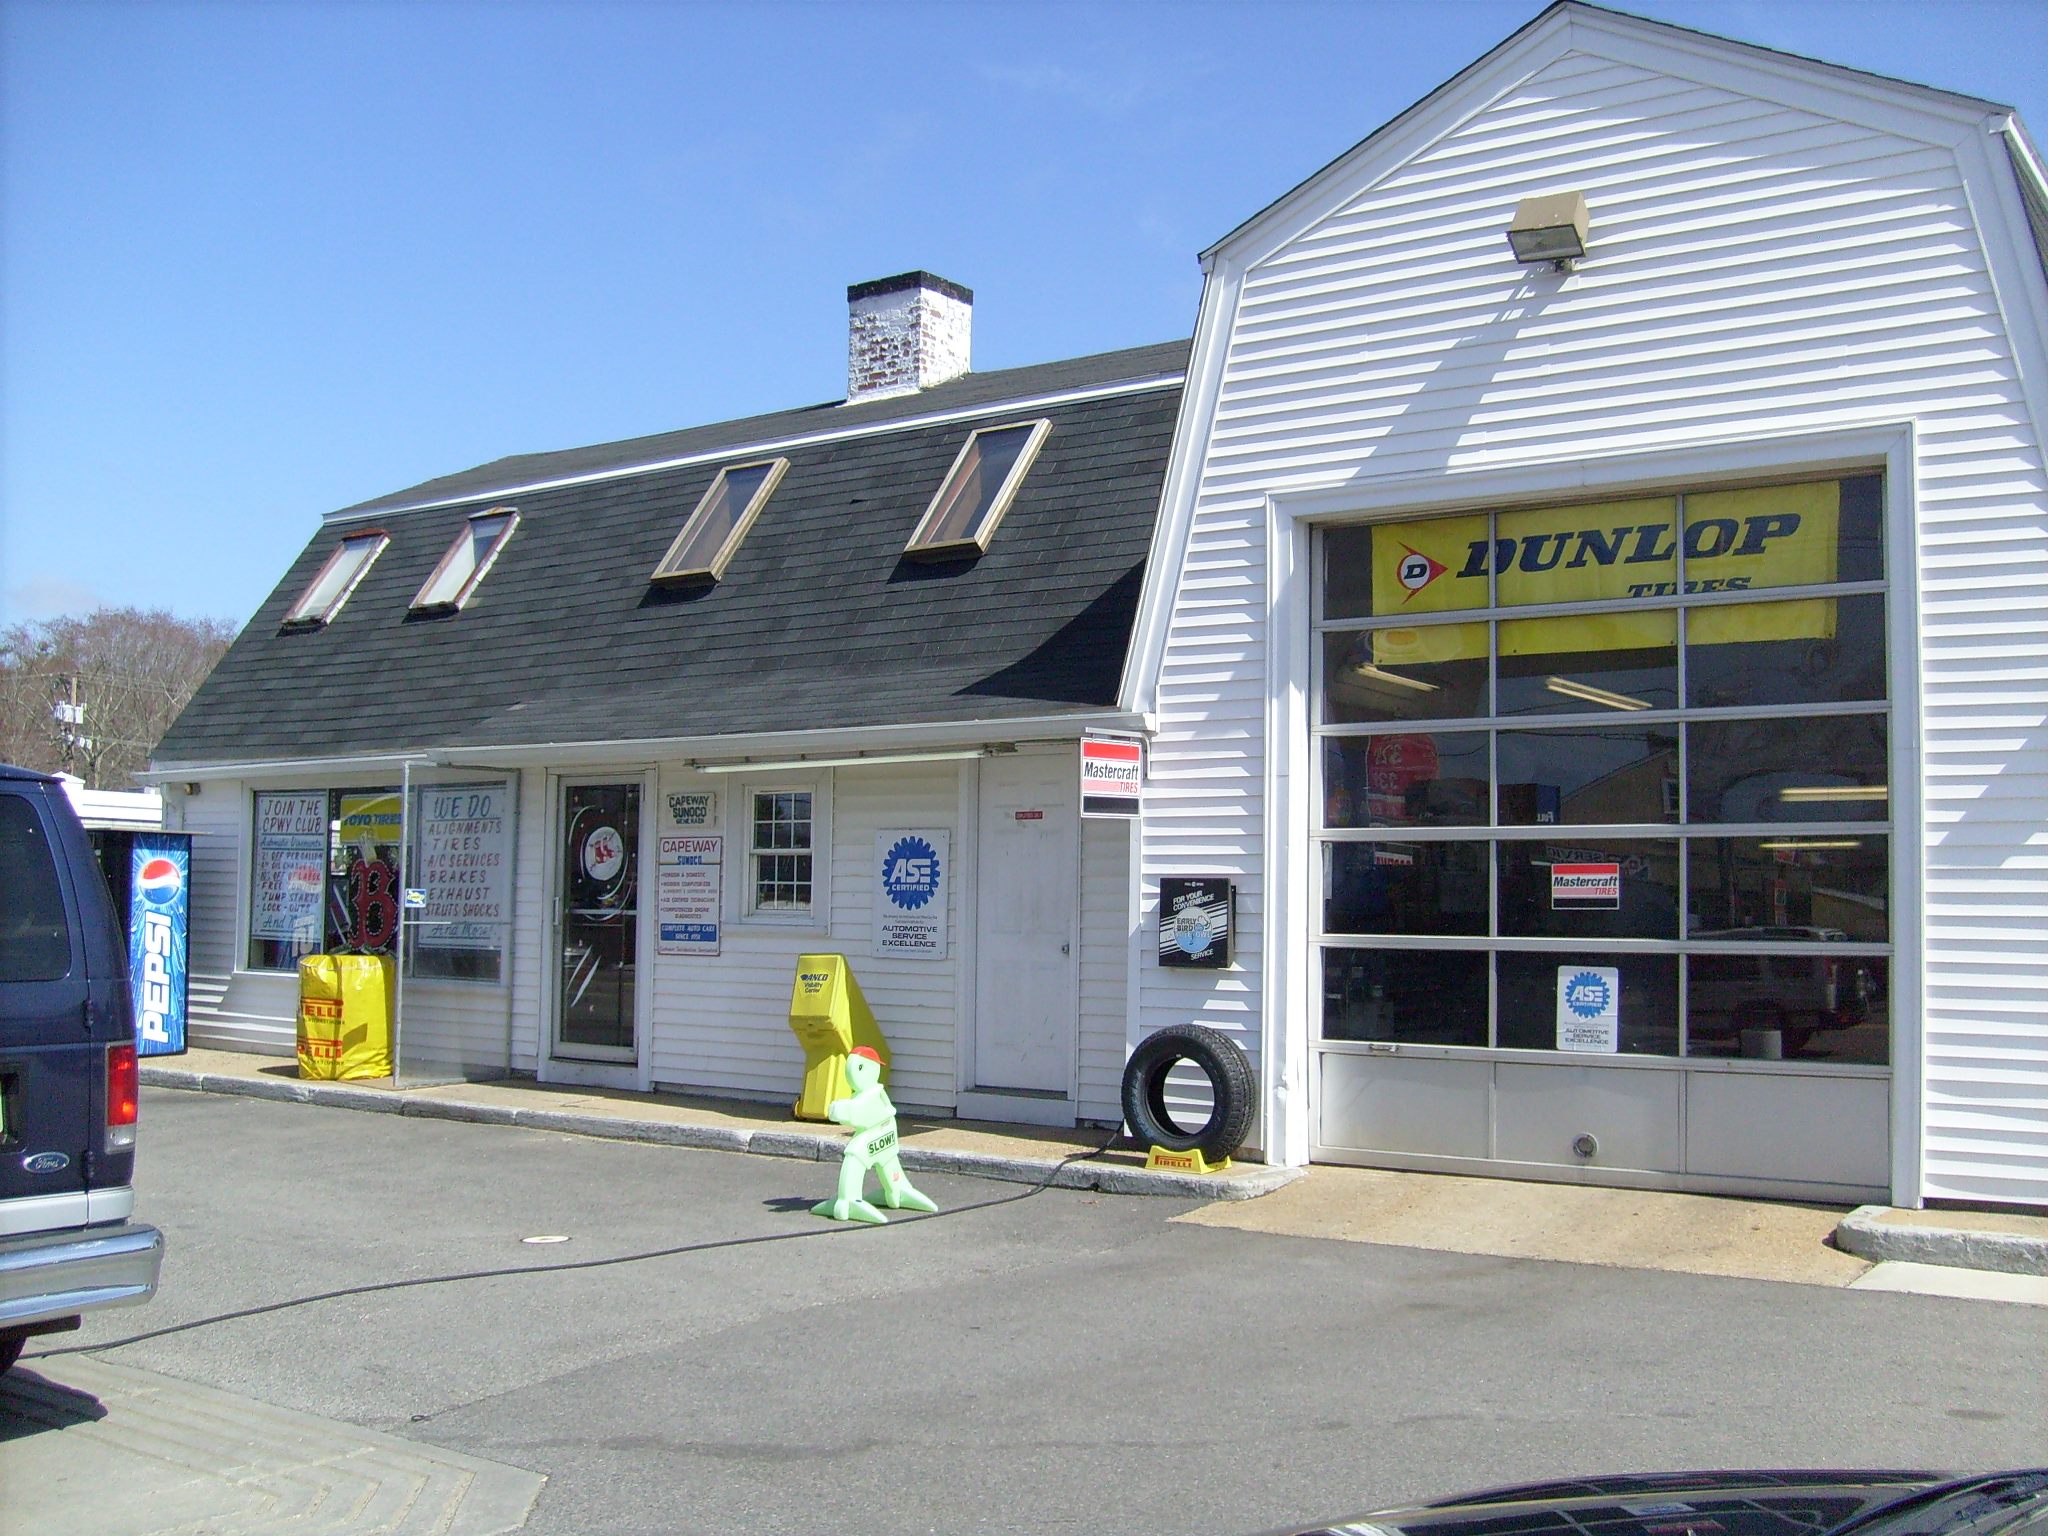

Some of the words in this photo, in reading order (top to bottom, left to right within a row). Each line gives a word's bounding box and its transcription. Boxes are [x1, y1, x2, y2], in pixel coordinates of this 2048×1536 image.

[1456, 513, 1800, 578] DUNLOP
[1403, 563, 1428, 580] D
[1084, 762, 1139, 780] Mastercraft
[1119, 782, 1138, 793] TIRES
[265, 799, 295, 816] JOIN
[300, 799, 321, 816] THE
[434, 796, 463, 819] WE
[468, 795, 491, 817] DO
[669, 796, 709, 808] CAPEWAY
[673, 807, 707, 818] SUNOCO
[262, 816, 291, 833] CPWY
[295, 816, 321, 833] CLUB
[428, 820, 502, 835] ALIGNMENTS
[433, 837, 480, 850] TIRES
[662, 840, 718, 853] CAPEWAY
[427, 854, 446, 868] A/C
[448, 853, 500, 868] SERVICES
[677, 855, 703, 865] SUNOCO
[429, 869, 486, 883] BRAKES
[889, 858, 931, 884] ASE
[261, 881, 283, 890] FREE
[891, 884, 930, 892] CERTIFIED
[1553, 876, 1618, 887] Mastercraft
[262, 891, 287, 901] JUMP
[289, 892, 320, 903] STARTS
[429, 887, 490, 900] EXHAUST
[1172, 895, 1186, 905] FOR
[1186, 890, 1203, 900] YOUR
[289, 903, 311, 913] OUTS
[1172, 893, 1215, 911] CONVENIENCE
[425, 903, 459, 916] STRUTS
[463, 903, 500, 917] SHOCKS
[661, 924, 685, 932] COMPLETE
[882, 924, 938, 933] AUTOMOTIVE
[892, 932, 927, 940] SERVICE
[882, 940, 937, 948] EXCELLENCE
[1191, 949, 1214, 960] SERVICE
[141, 911, 173, 1045] PEPSI
[1570, 985, 1604, 1002] ASE
[304, 1005, 342, 1018] ELLI
[868, 1132, 895, 1154] SLOW!
[35, 1157, 60, 1169] Ford
[1154, 1155, 1192, 1168] PIRELLI
